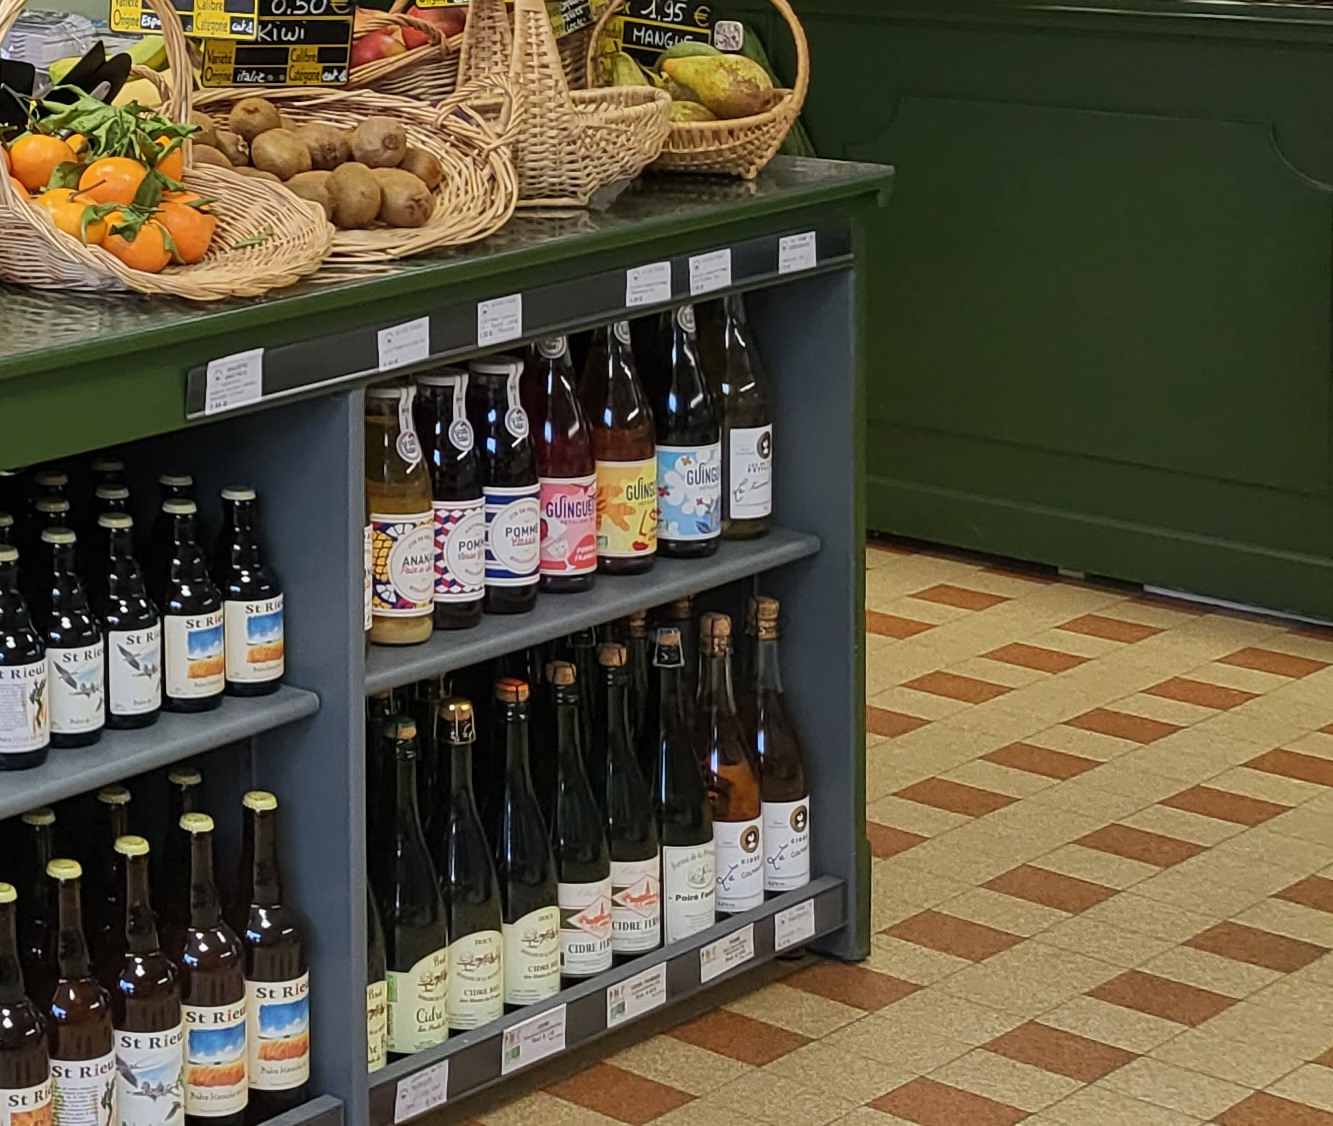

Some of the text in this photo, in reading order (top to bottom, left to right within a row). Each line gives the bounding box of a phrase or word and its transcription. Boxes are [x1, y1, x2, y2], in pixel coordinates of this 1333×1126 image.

[694, 6, 710, 26] €
[245, 604, 260, 614] St
[185, 618, 200, 629] St
[126, 634, 141, 645] St
[62, 652, 79, 663] St
[612, 920, 641, 930] CIDRE
[568, 942, 596, 953] CIDRE
[256, 986, 276, 999] St
[185, 1011, 207, 1024] St
[120, 1035, 142, 1049] St
[51, 1065, 72, 1080] St
[8, 1094, 29, 1107] St
